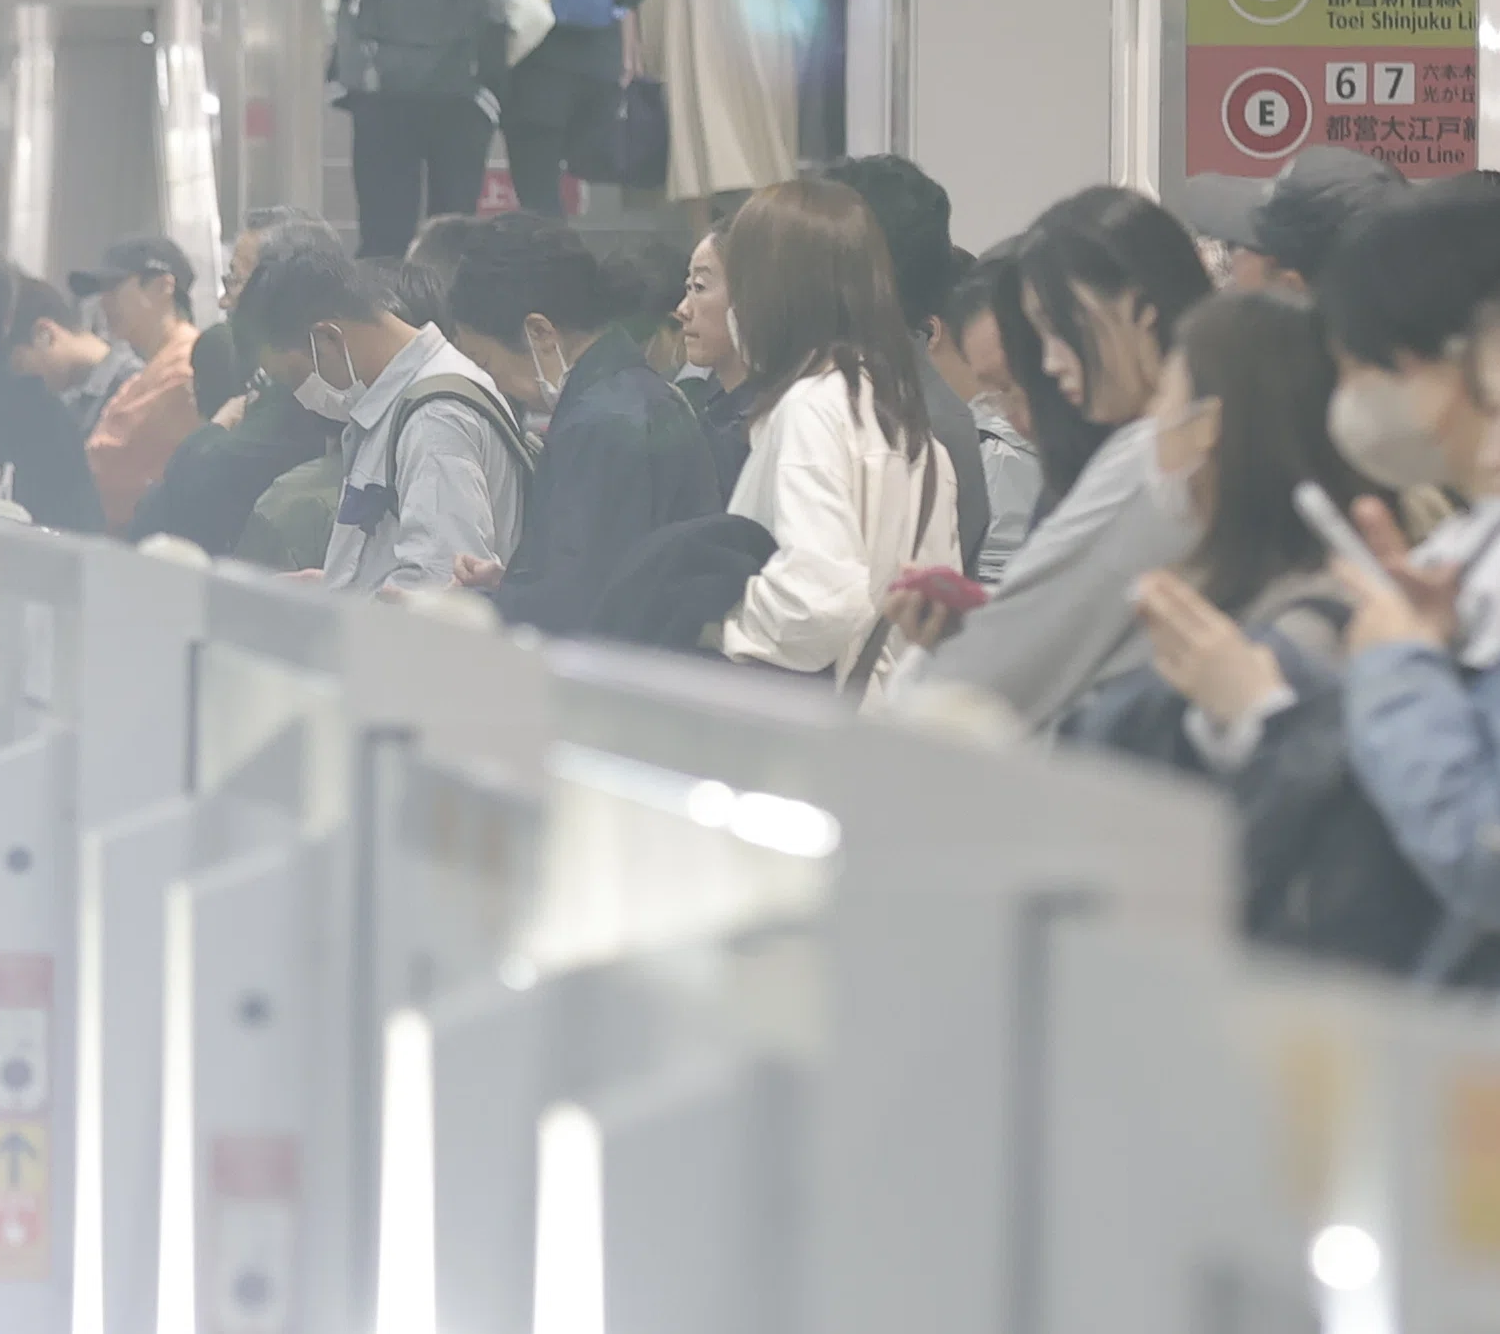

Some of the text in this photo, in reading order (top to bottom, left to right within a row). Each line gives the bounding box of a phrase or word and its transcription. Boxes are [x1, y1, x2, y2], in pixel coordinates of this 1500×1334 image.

[1326, 10, 1365, 30] Toei
[1372, 10, 1452, 35] Shinjuku
[1336, 66, 1357, 100] 6
[1384, 67, 1404, 100] 7
[1259, 99, 1275, 127] E
[1427, 145, 1466, 164] Line
